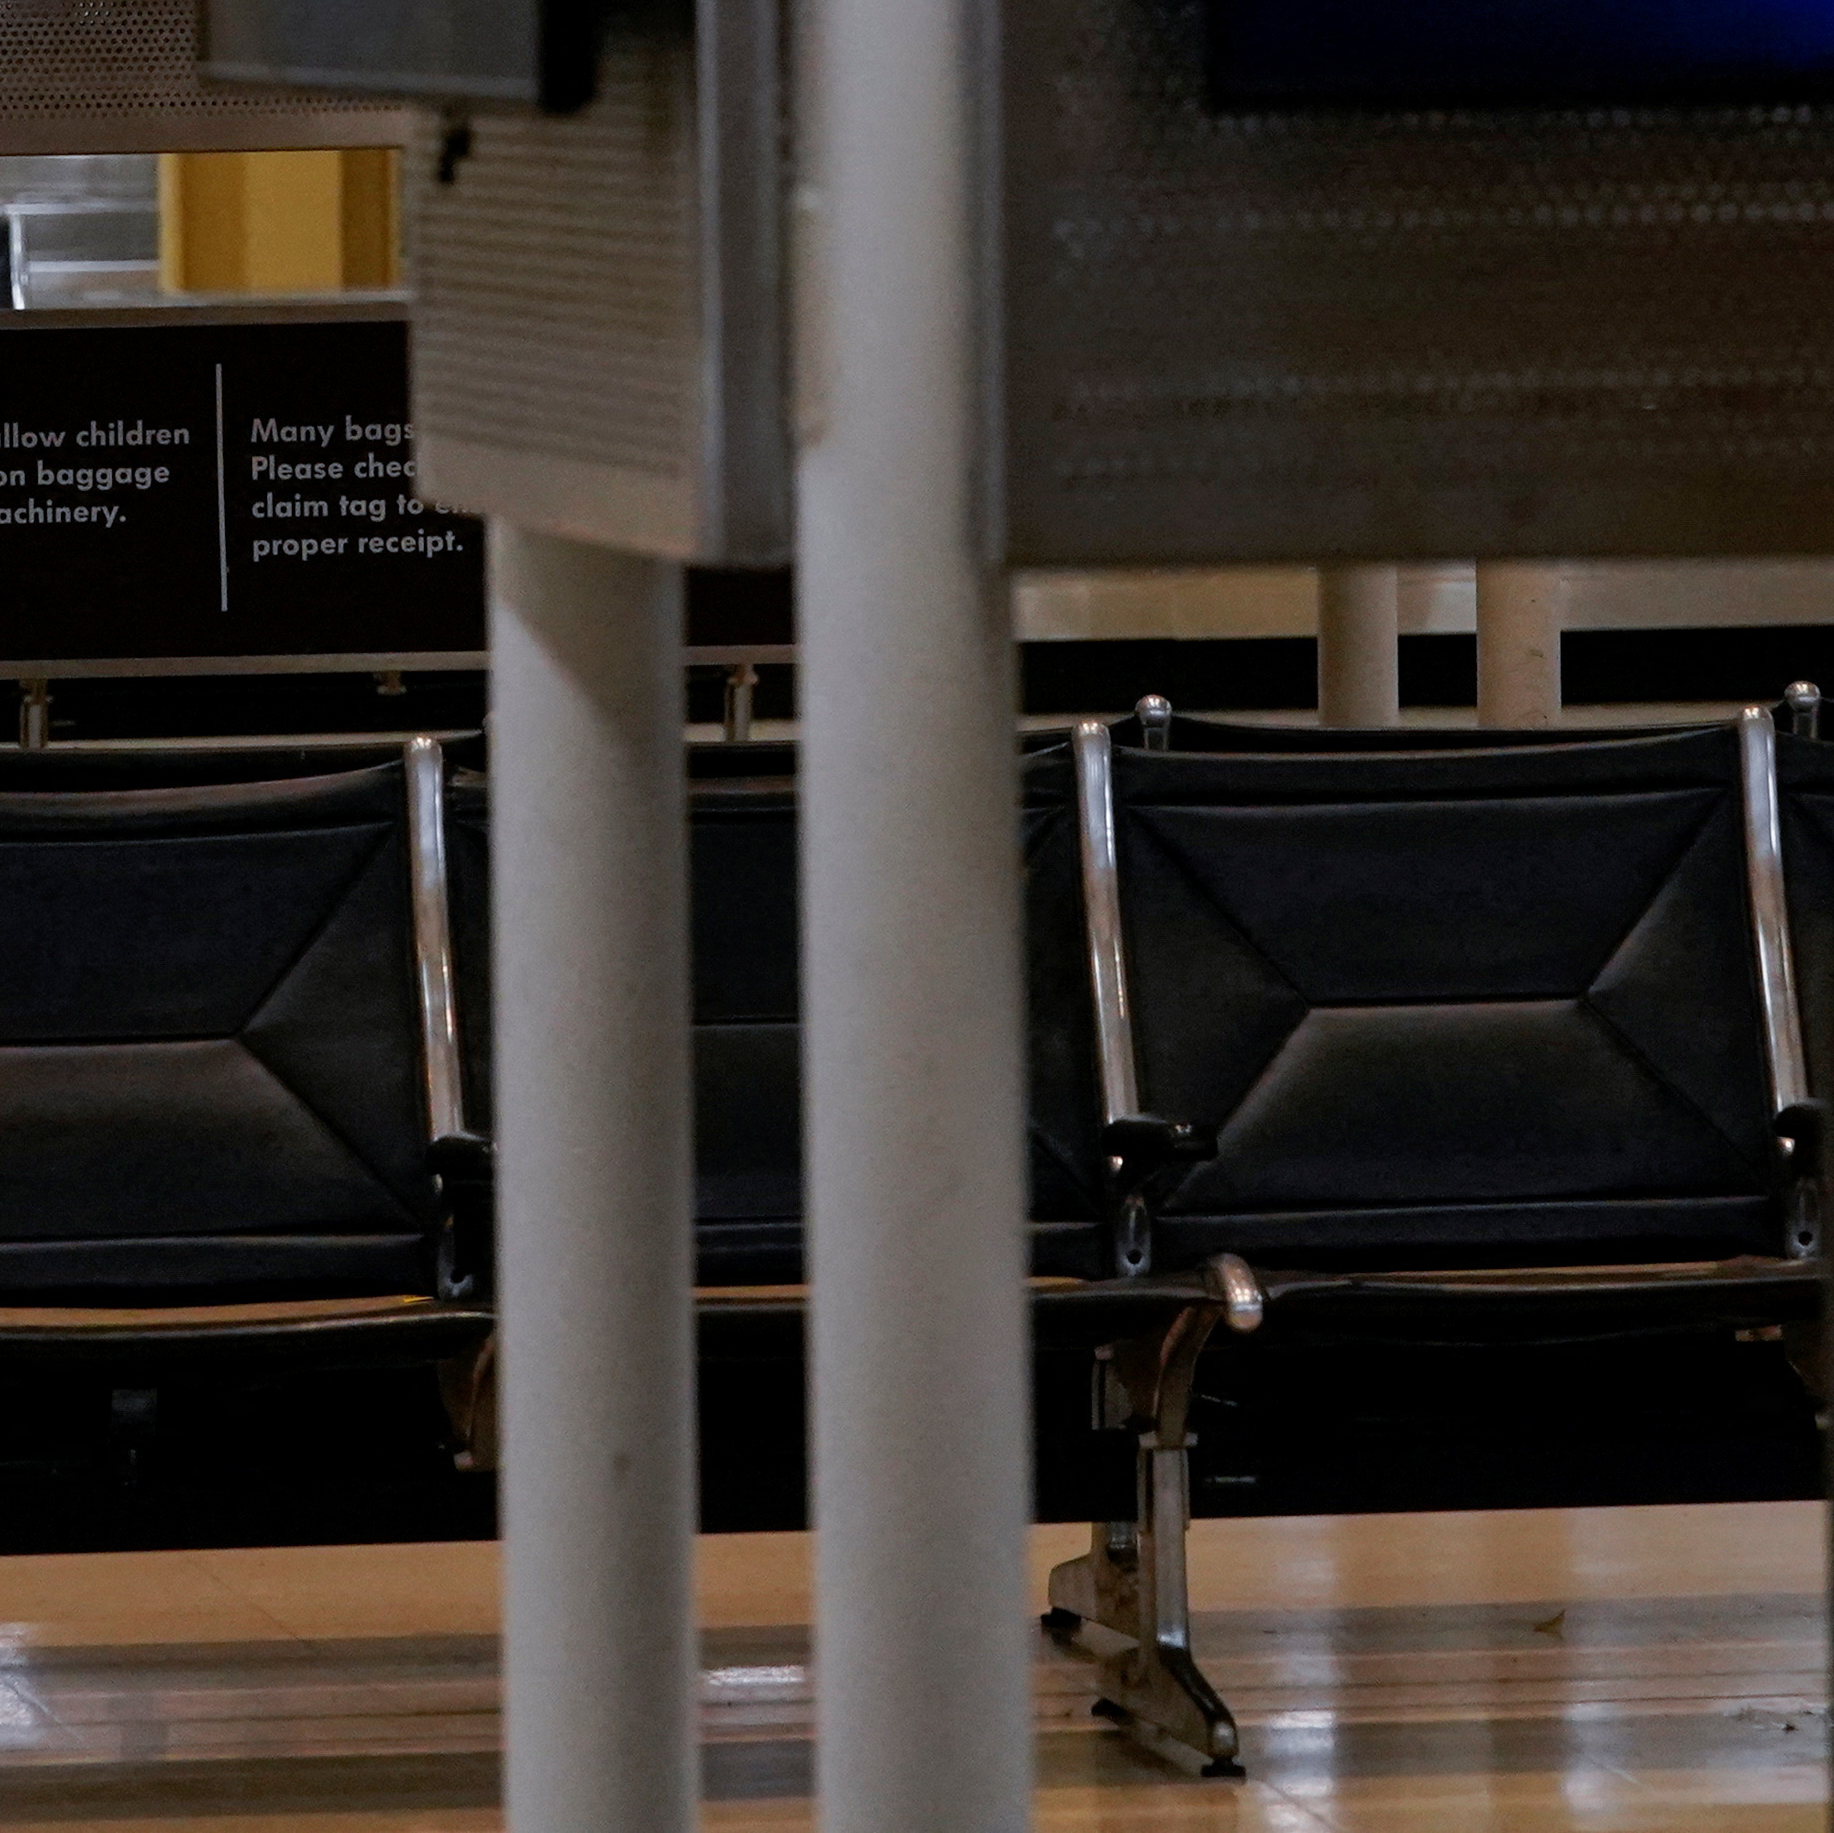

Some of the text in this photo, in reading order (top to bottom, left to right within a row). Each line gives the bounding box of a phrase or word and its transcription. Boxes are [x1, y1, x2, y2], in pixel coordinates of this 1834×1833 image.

[75, 421, 190, 448] children
[250, 413, 414, 448] Many bags
[37, 460, 170, 492] baggage
[251, 451, 415, 481] Please chec
[251, 492, 329, 519] claim
[338, 494, 387, 523] tag
[396, 489, 425, 515] to
[252, 528, 464, 563] proper receipt.
